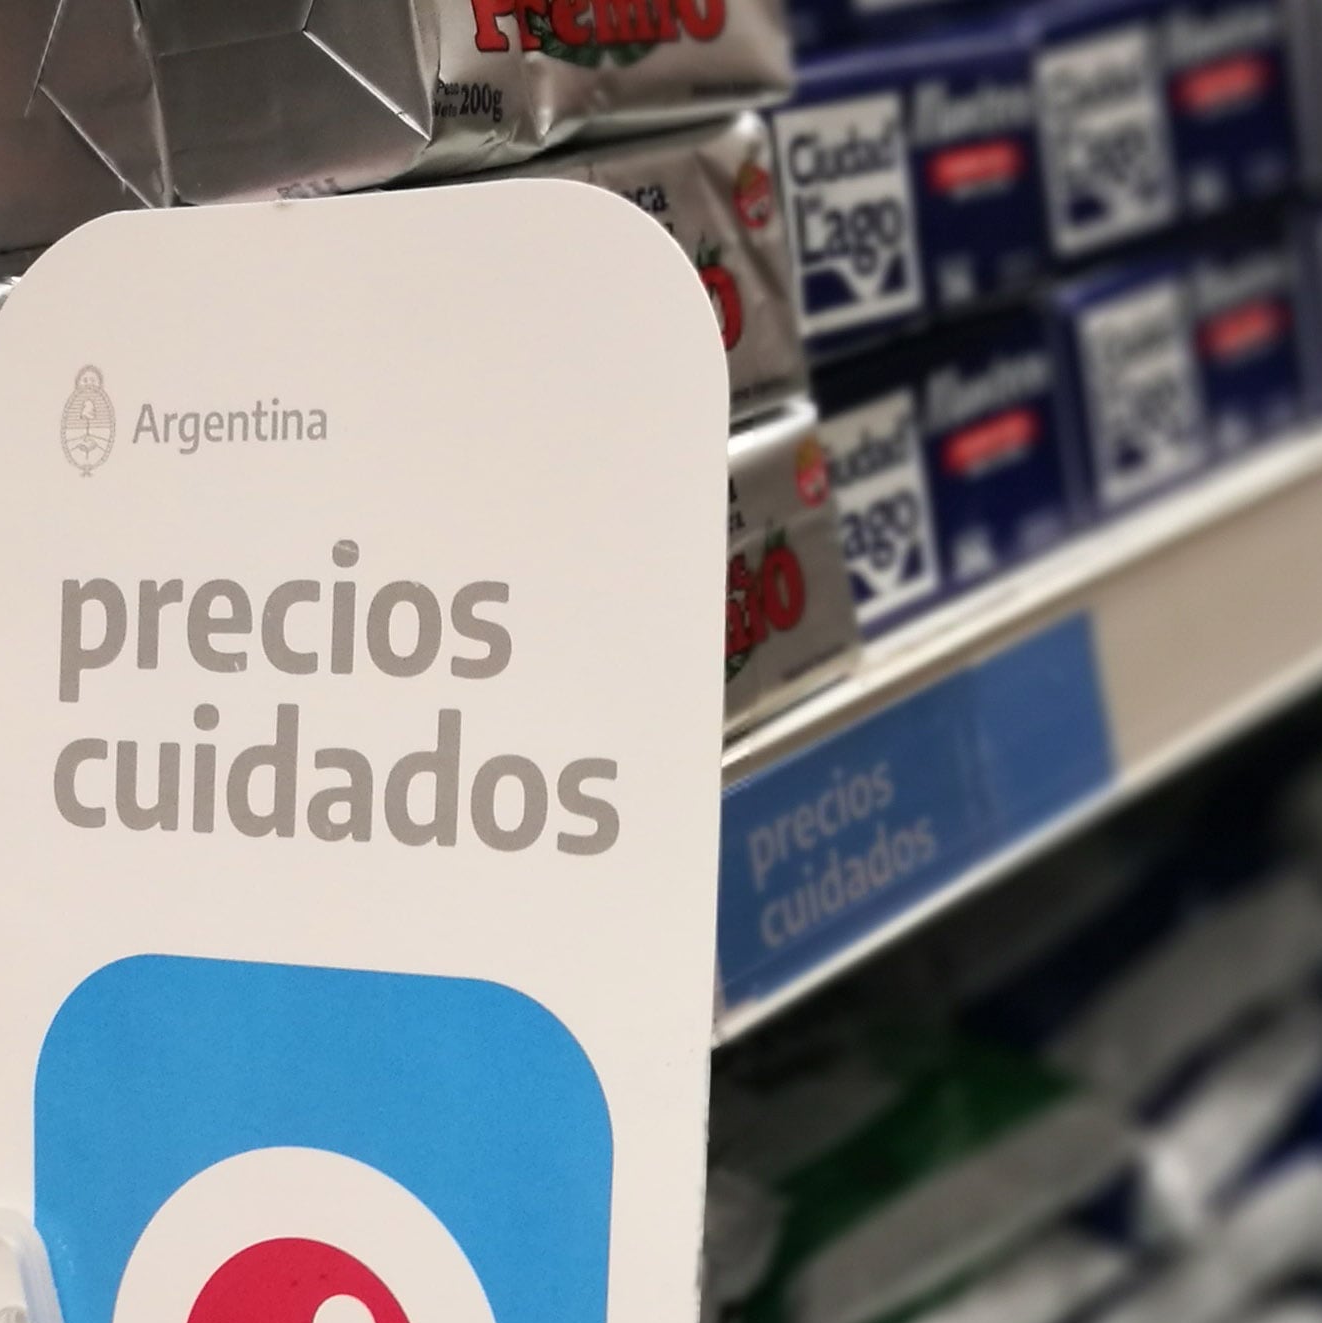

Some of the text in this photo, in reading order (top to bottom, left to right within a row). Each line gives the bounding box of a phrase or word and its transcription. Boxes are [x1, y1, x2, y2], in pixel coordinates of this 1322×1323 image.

[459, 83, 504, 123] 200g
[132, 398, 329, 457] Argentina
[829, 418, 909, 489] iudad
[841, 489, 919, 572] ago
[58, 539, 513, 703] precios
[53, 702, 621, 857] cuidados
[746, 761, 896, 894] precios
[760, 816, 936, 948] cuidados
